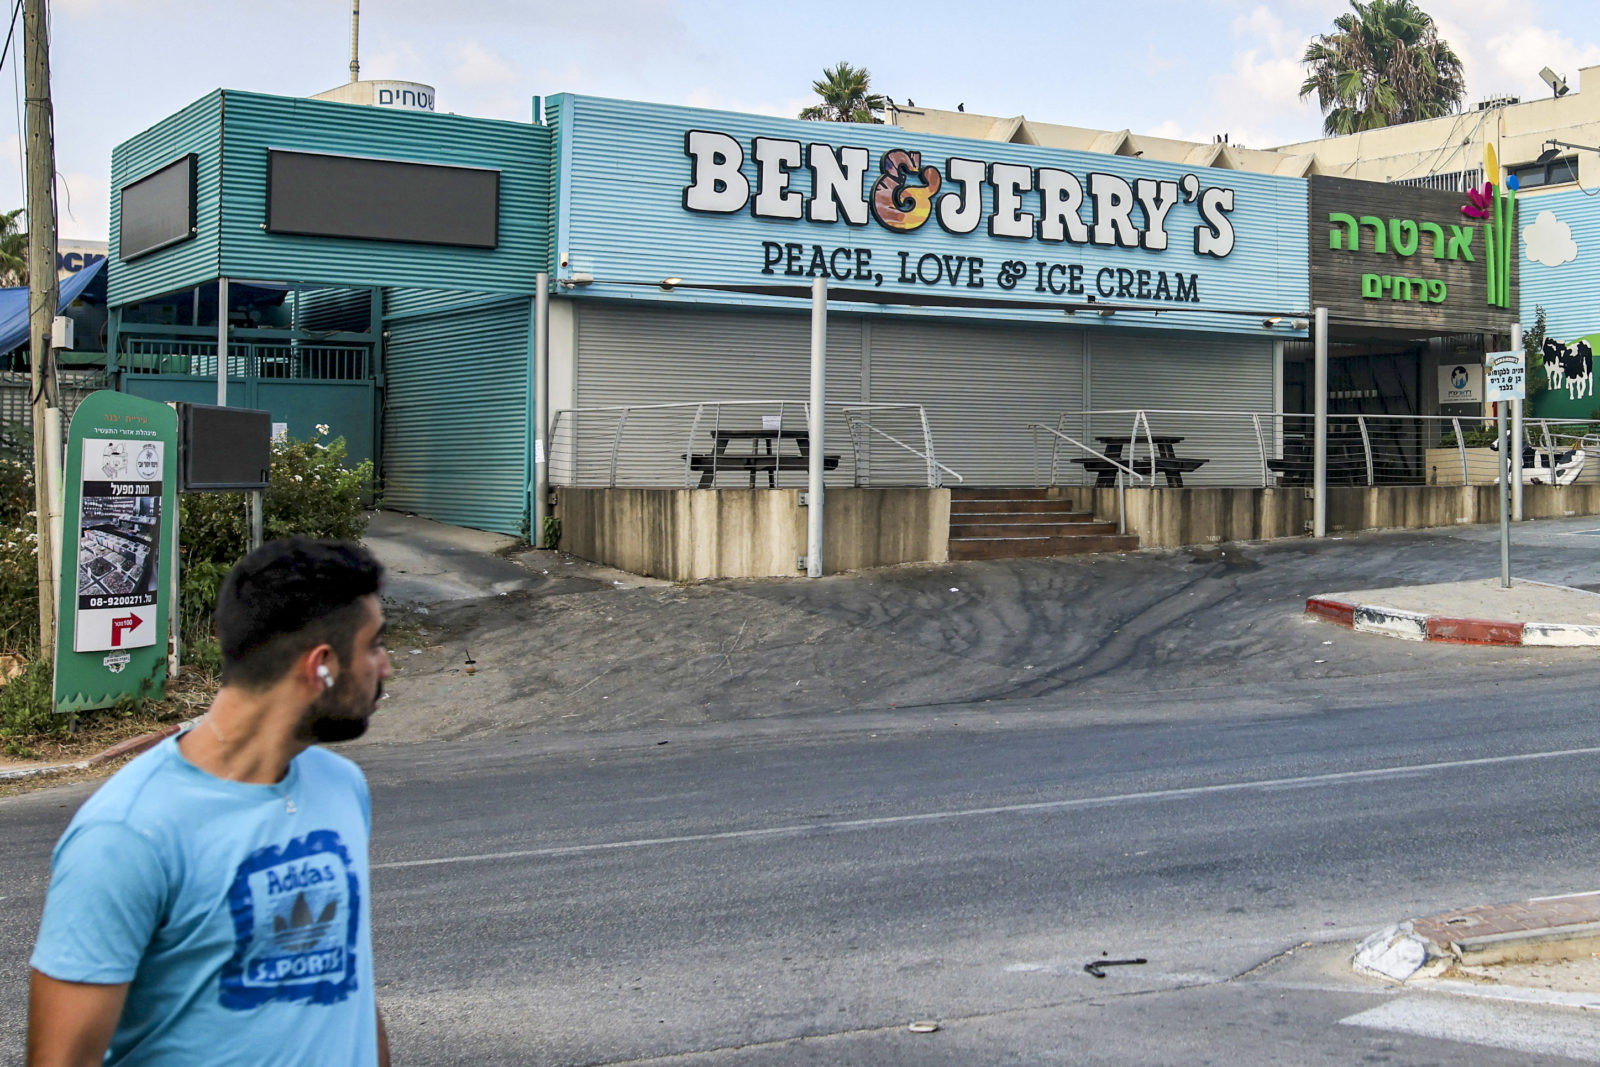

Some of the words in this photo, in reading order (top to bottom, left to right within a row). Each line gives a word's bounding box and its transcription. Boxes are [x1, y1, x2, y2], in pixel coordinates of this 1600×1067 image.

[1328, 212, 1476, 262] ארטרה
[761, 241, 883, 287] PEACE,
[897, 251, 984, 288] LOVE
[997, 259, 1027, 290] &
[1035, 261, 1084, 295] ICE
[1096, 267, 1200, 302] CREAM
[1361, 273, 1447, 303] פרחים
[110, 482, 134, 496] מפעל
[135, 484, 150, 495] חנות
[90, 596, 142, 607] 08-9200271
[266, 862, 335, 895] Adidas
